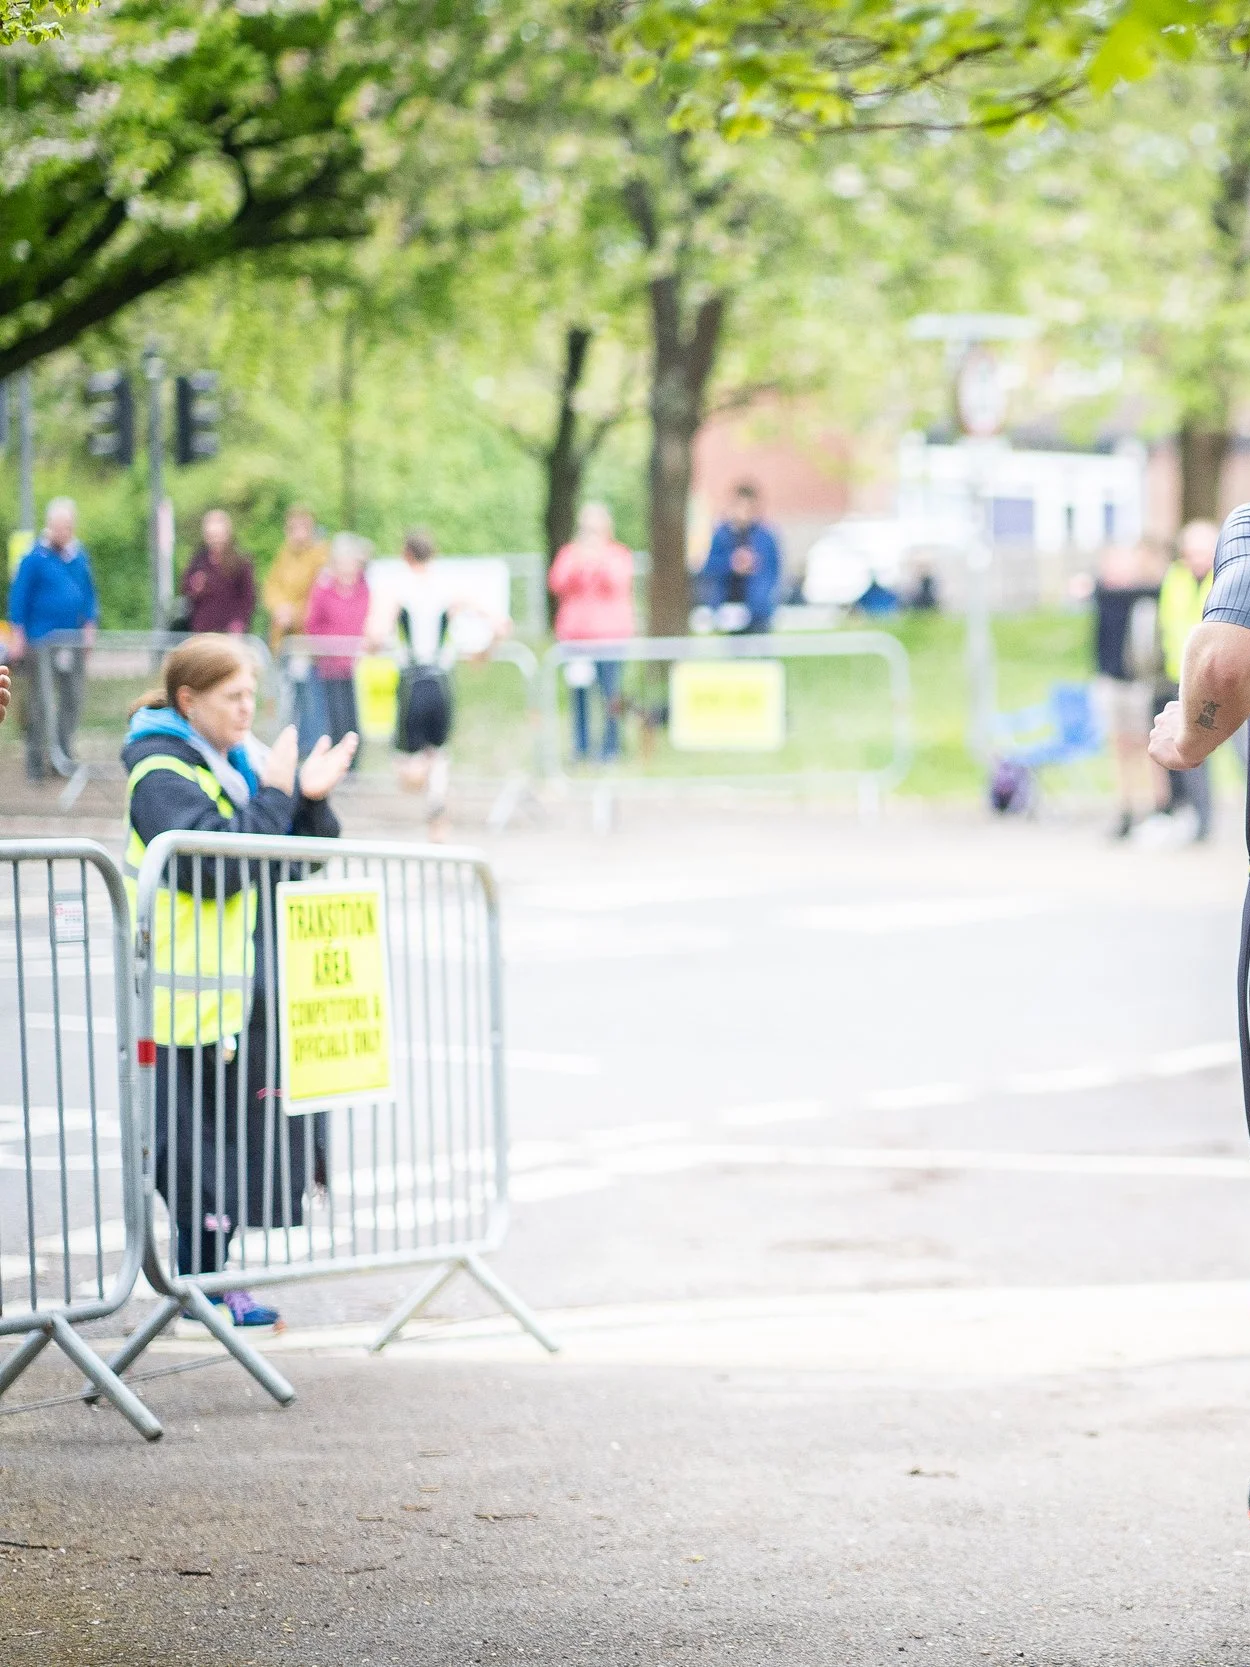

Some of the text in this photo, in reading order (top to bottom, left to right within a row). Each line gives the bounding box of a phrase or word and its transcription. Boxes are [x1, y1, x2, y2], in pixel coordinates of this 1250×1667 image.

[289, 902, 376, 940] TRANSITION
[314, 949, 352, 987] AREA
[354, 1029, 380, 1054] ONLY
